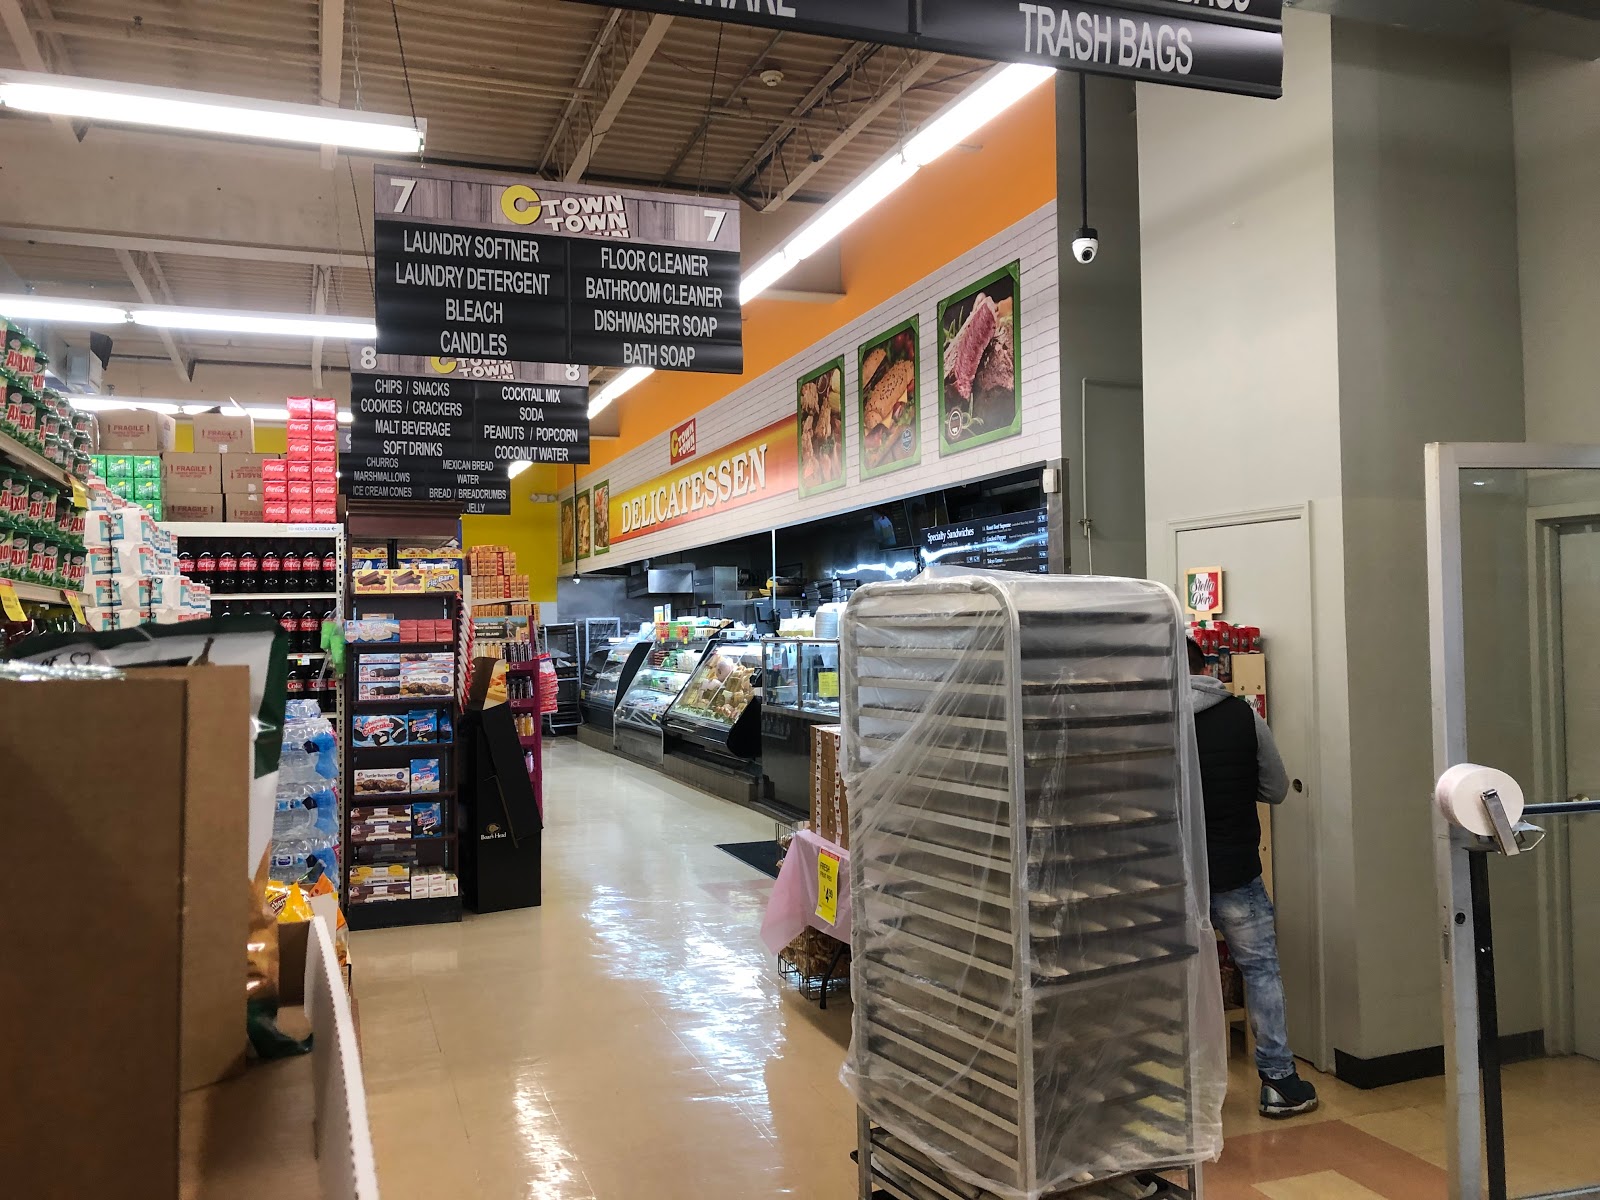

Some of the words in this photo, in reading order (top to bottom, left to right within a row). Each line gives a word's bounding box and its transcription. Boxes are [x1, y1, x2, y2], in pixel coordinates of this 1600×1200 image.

[1019, 3, 1111, 64] TRASH
[1118, 19, 1193, 74] BAGS
[390, 178, 417, 213] 7
[541, 195, 624, 216] TOWN
[544, 213, 628, 233] TOWN
[704, 210, 726, 242] 7
[404, 230, 473, 257] LAUNDRY
[475, 238, 540, 263] SOFTNER
[601, 248, 646, 272] FLOOR
[648, 251, 709, 277] CLEANER
[396, 262, 464, 288] LAUNDRY
[467, 267, 550, 295] DETERGENT
[585, 277, 660, 304] BATHROOM
[663, 284, 723, 308] CLEANER
[446, 299, 503, 324] BLEACH
[595, 309, 680, 335] DISHWASHER
[683, 315, 717, 338] SOAP
[440, 330, 507, 356] CANDLES
[360, 346, 376, 369] 8
[623, 342, 658, 365] BATH
[660, 346, 696, 368] SOAP
[458, 364, 513, 379] TOWN
[565, 364, 580, 381] 8
[375, 379, 402, 394] CHIPS
[412, 380, 450, 396] SNACKS
[502, 386, 544, 402] COCKTAIL
[546, 389, 560, 403] MIX
[361, 399, 402, 414] COOKIES
[413, 402, 462, 417] CRACKERS
[519, 407, 544, 421] SODA
[290, 423, 309, 431] Coca-Cola
[314, 423, 335, 432] Coca-Cola
[376, 420, 400, 434] MALT
[402, 421, 451, 437] BEVERAGE
[484, 425, 524, 440] PEANUTS
[536, 427, 578, 442] POPCORN
[290, 444, 309, 452] Coca-Cola
[314, 444, 335, 453] Coca-Cola
[383, 440, 408, 455] SOFT
[409, 442, 443, 456] DRINKS
[495, 445, 538, 460] COCONUT
[539, 447, 568, 461] WATER
[265, 464, 285, 472] Coca-Cola
[366, 457, 398, 468] CHURROS
[443, 460, 471, 470] MEXICAN
[472, 460, 493, 471] BREAD
[290, 465, 309, 473] Coca-Cola
[314, 465, 334, 473] Coca-Cola
[354, 471, 410, 482] MARSHMALLOWS
[457, 474, 479, 484] WATER
[265, 485, 285, 494] Coca-Cola
[290, 486, 310, 494] Coca-Cola
[315, 486, 335, 494] Coca-Cola
[352, 486, 363, 495] ICE
[365, 486, 388, 497] CREAM
[389, 487, 412, 497] CONES
[429, 488, 451, 499] BREAD
[459, 489, 506, 499] BREADCRUMBS
[621, 443, 767, 534] DELICATESSEN
[266, 506, 286, 515] Coca-Cola
[290, 507, 310, 515] Coca-Cola
[315, 507, 334, 515] Coca-Cola
[467, 503, 485, 513] JELLY
[927, 530, 947, 545] Specialty
[947, 527, 975, 540] Sandwiches
[197, 560, 216, 570] Coca-Cola
[219, 559, 237, 570] Coca-Cola
[239, 559, 257, 569] Coca-Cola
[262, 559, 280, 569] Coca-Cola
[284, 560, 301, 569] Coca-Cola
[303, 559, 321, 569] Coca-Cola
[287, 682, 303, 691] Coke
[364, 717, 389, 728] Chocolate
[362, 722, 394, 736] Cupcakes
